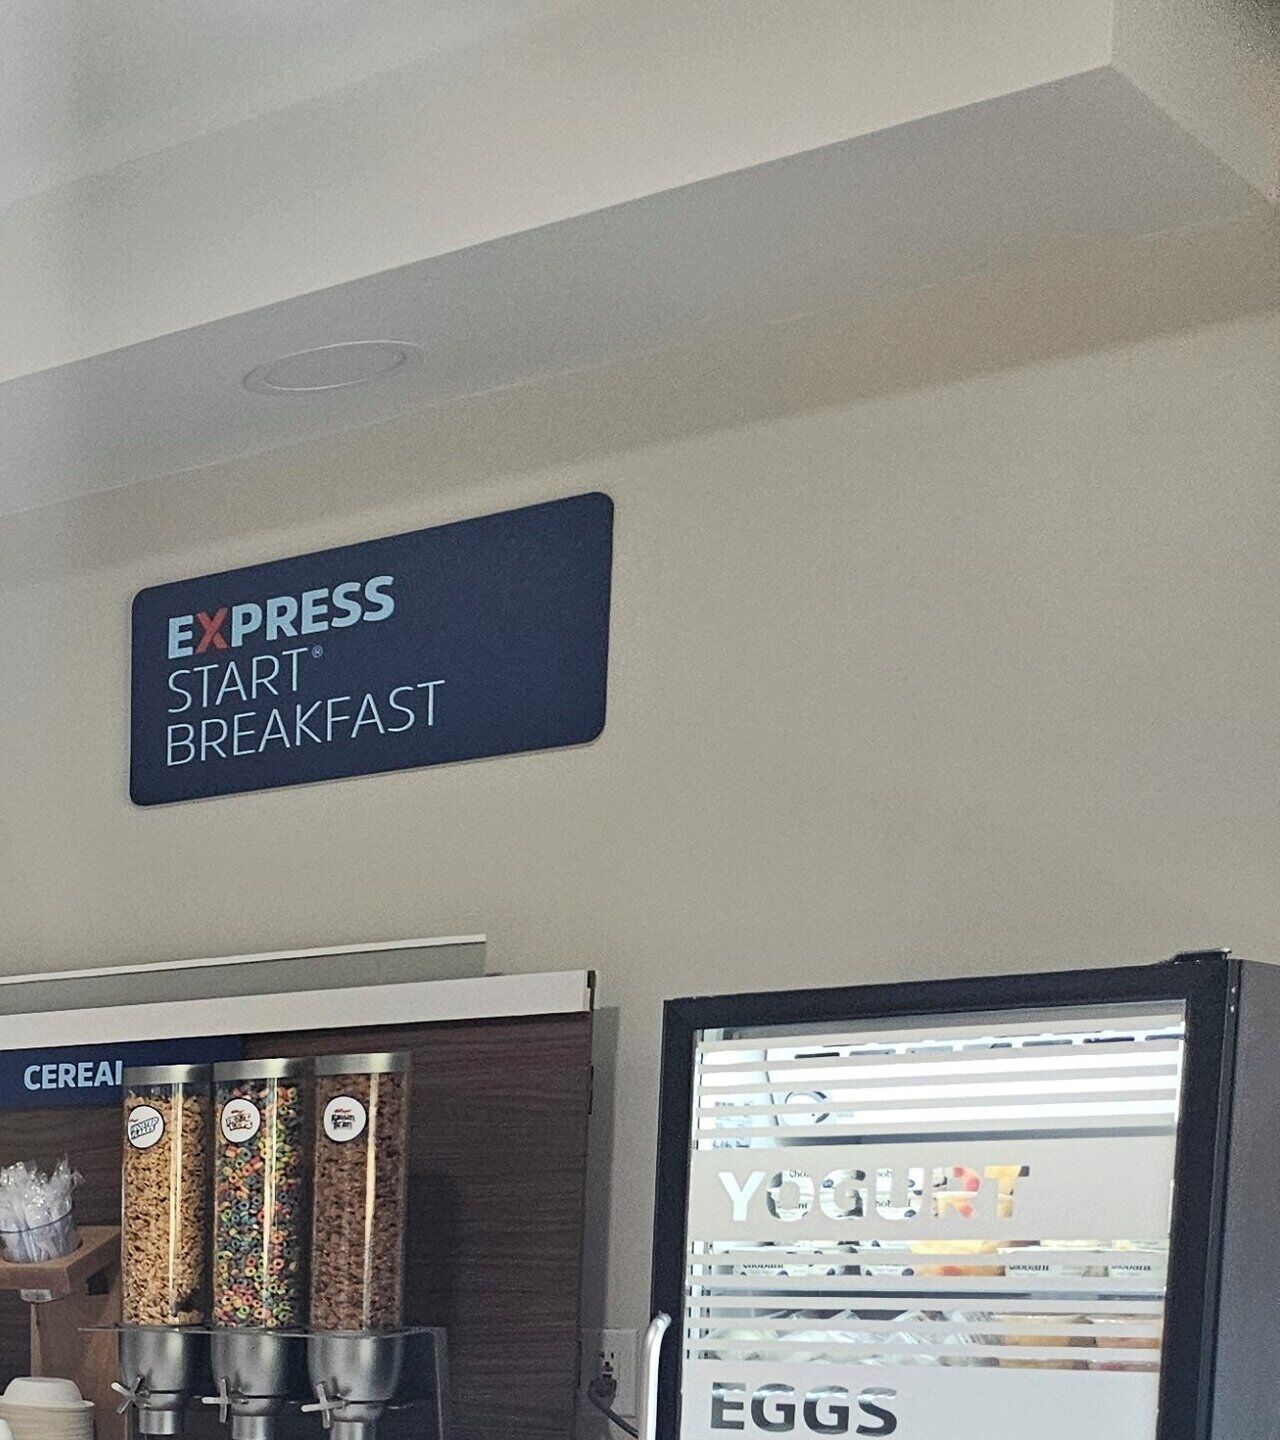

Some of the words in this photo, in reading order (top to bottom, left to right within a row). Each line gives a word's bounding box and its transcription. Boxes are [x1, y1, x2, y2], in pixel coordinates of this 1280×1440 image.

[167, 575, 395, 659] EXPRESS
[166, 679, 446, 766] BREAKFAST
[718, 1165, 1030, 1222] YOGURT
[710, 1381, 898, 1438] EGGS
